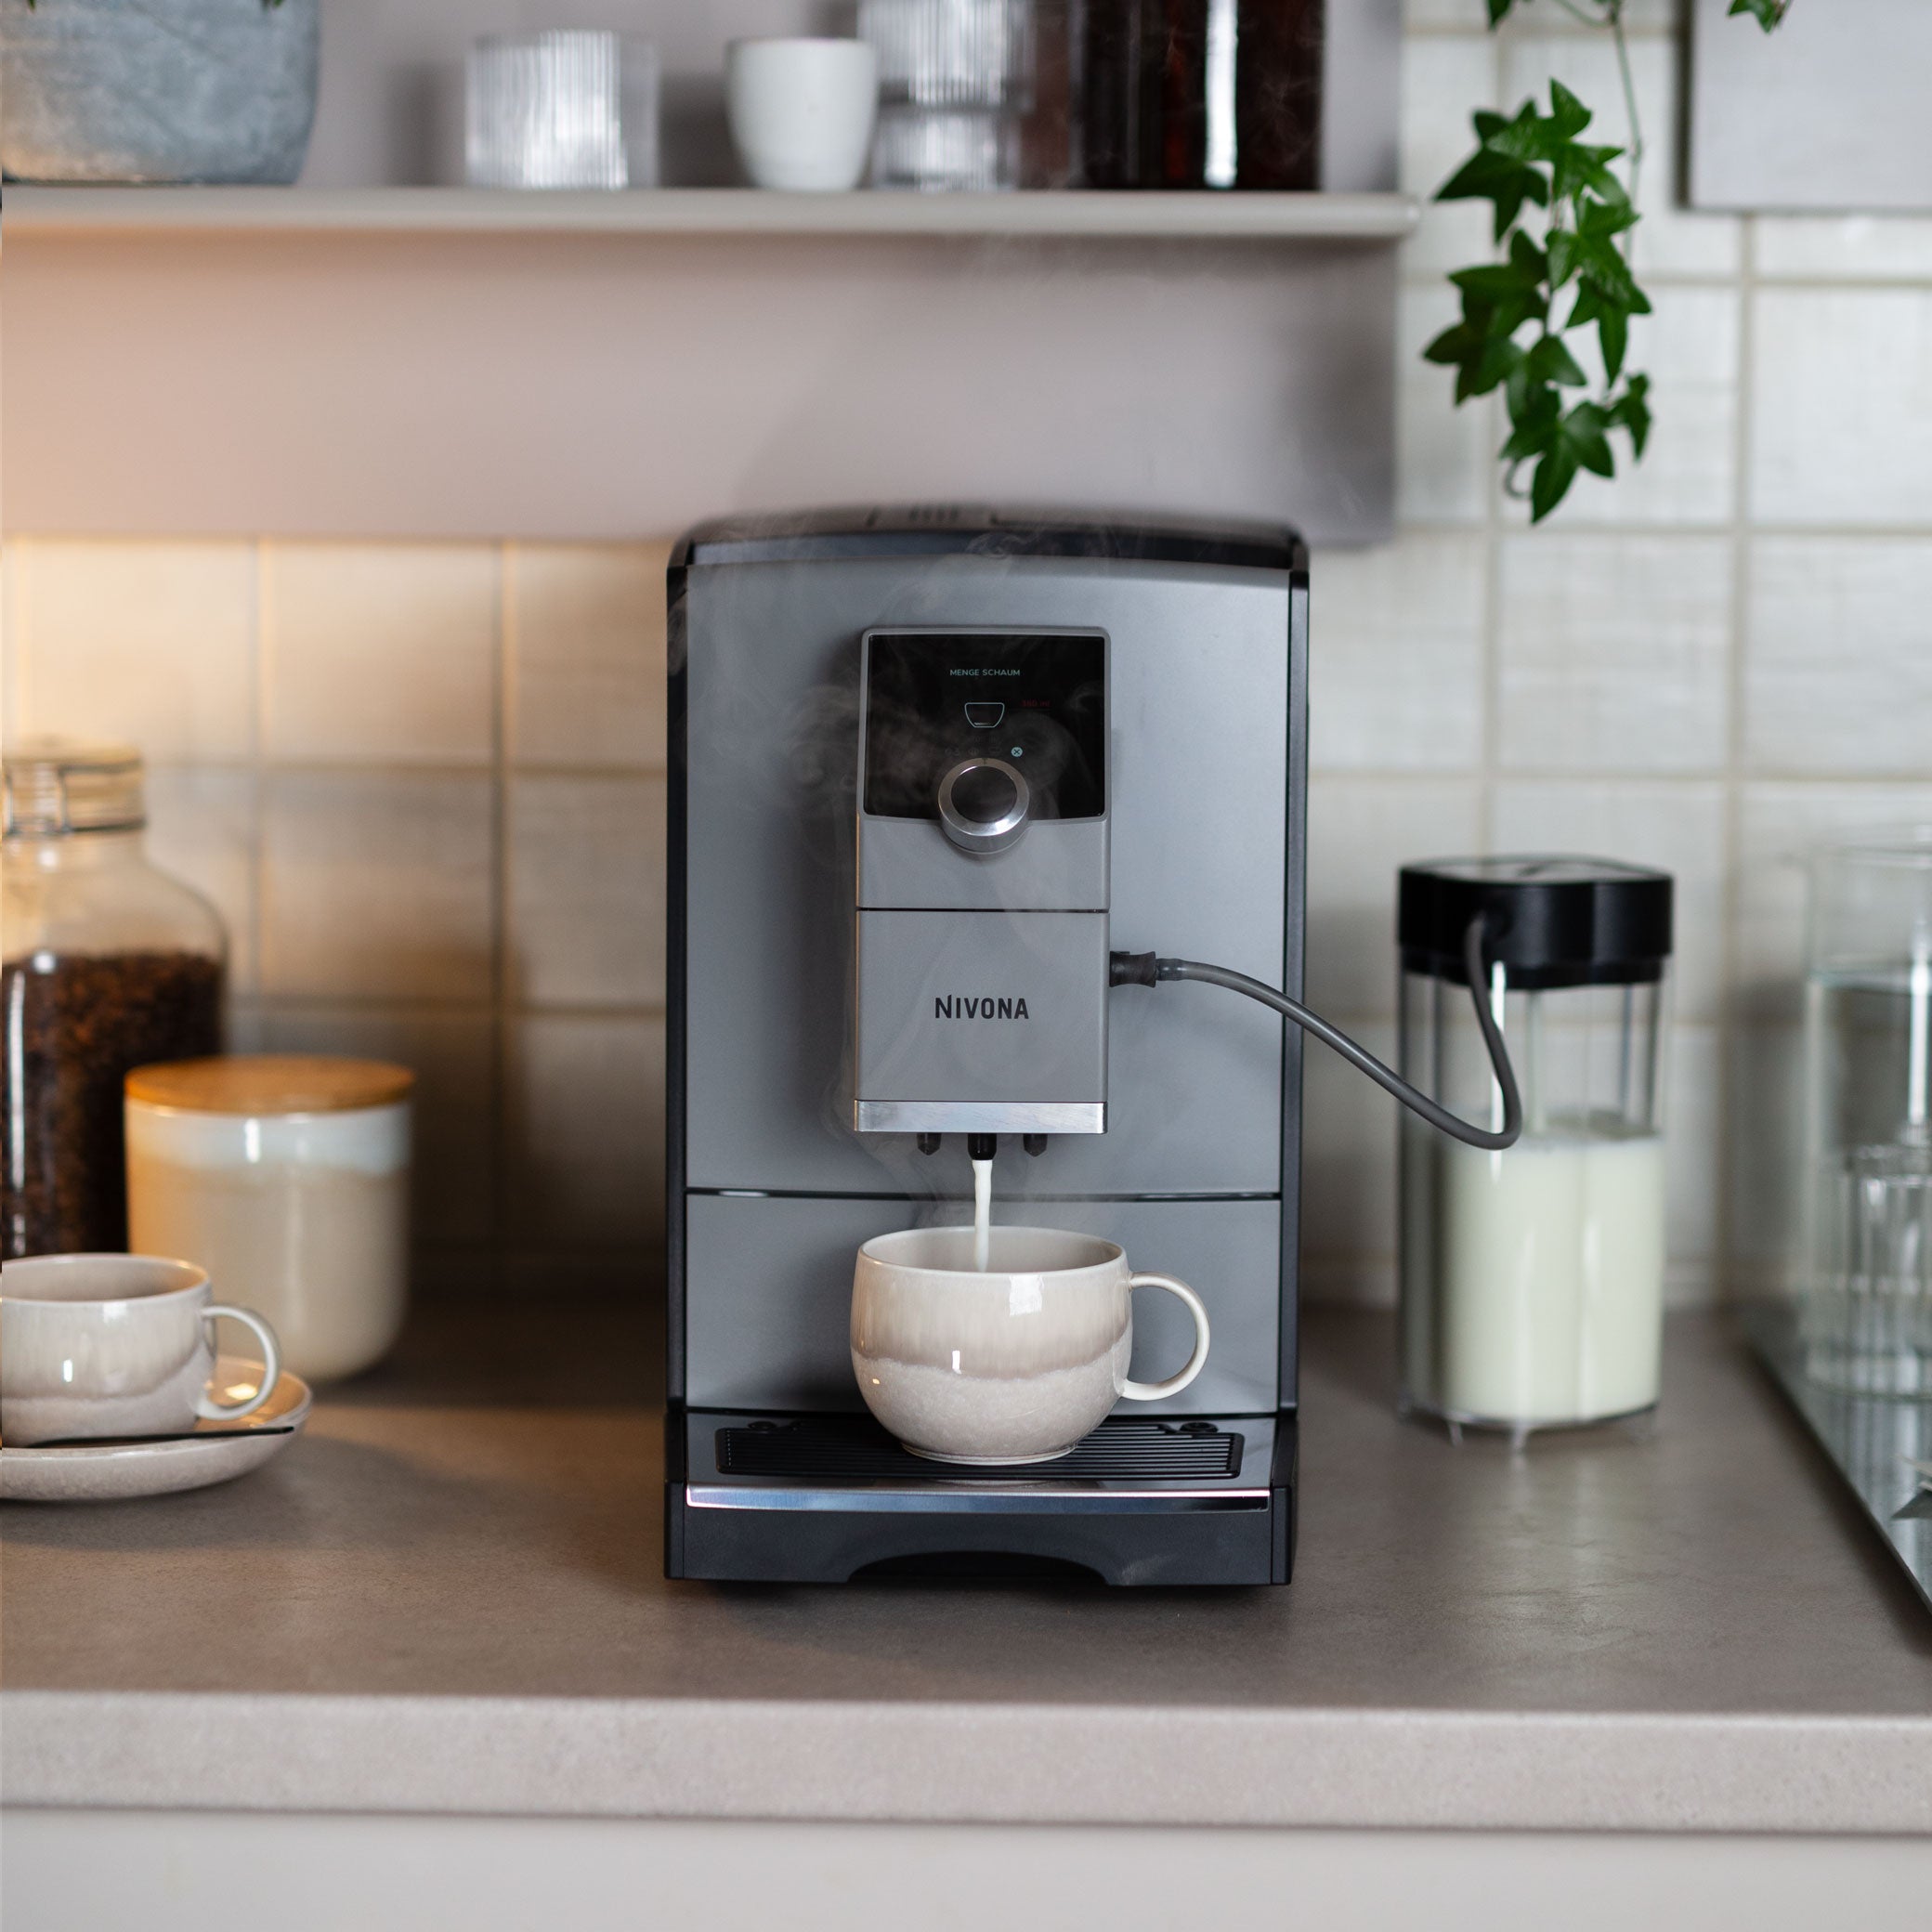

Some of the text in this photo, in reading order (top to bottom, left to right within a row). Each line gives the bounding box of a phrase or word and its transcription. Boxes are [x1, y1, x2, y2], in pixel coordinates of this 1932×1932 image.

[949, 669, 1021, 677] MENGE SCHAUM
[934, 994, 1029, 1020] NIVONA
